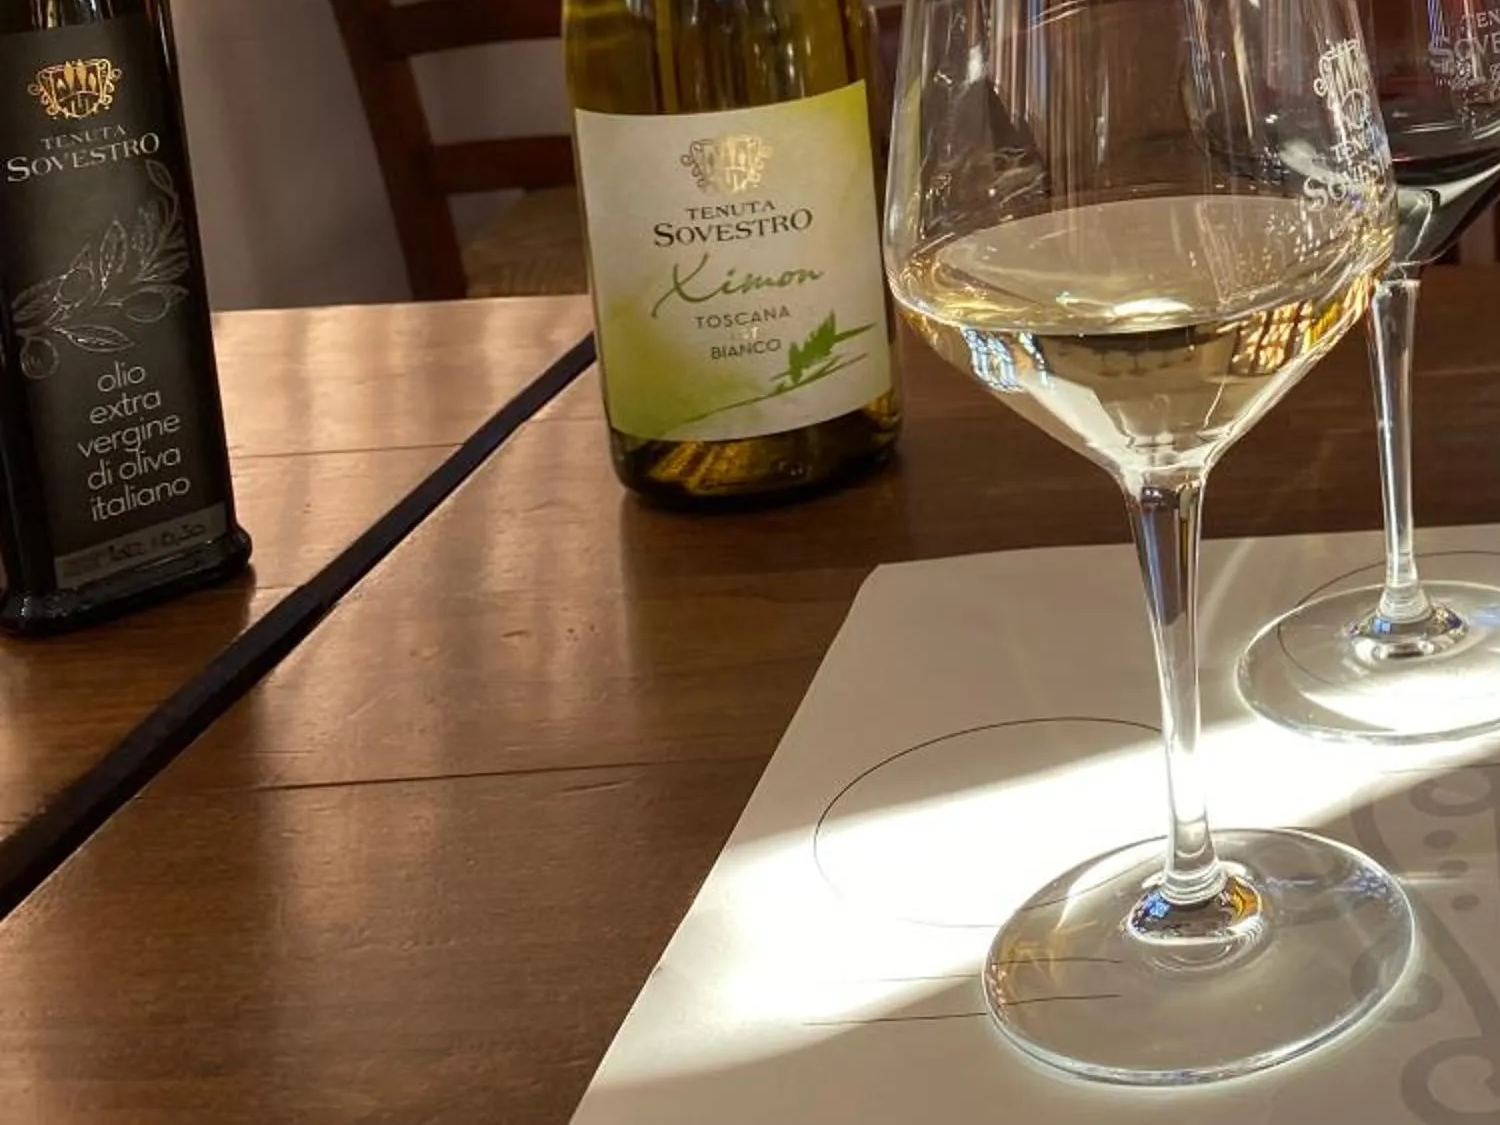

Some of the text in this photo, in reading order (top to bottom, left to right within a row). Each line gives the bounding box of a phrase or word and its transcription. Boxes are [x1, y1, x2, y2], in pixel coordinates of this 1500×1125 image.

[40, 124, 127, 151] TENUTA
[6, 131, 161, 183] SOVESTRO
[653, 207, 814, 249] SOVESTRO
[685, 199, 777, 222] TENUTA
[650, 251, 826, 319] Ximon
[693, 305, 792, 330] TOSCANA
[710, 337, 782, 361] BIANCO
[97, 360, 147, 393] olio
[89, 390, 162, 425] extra
[76, 414, 182, 459] vergine
[87, 448, 182, 491] di oliva
[89, 476, 192, 522] italiano
